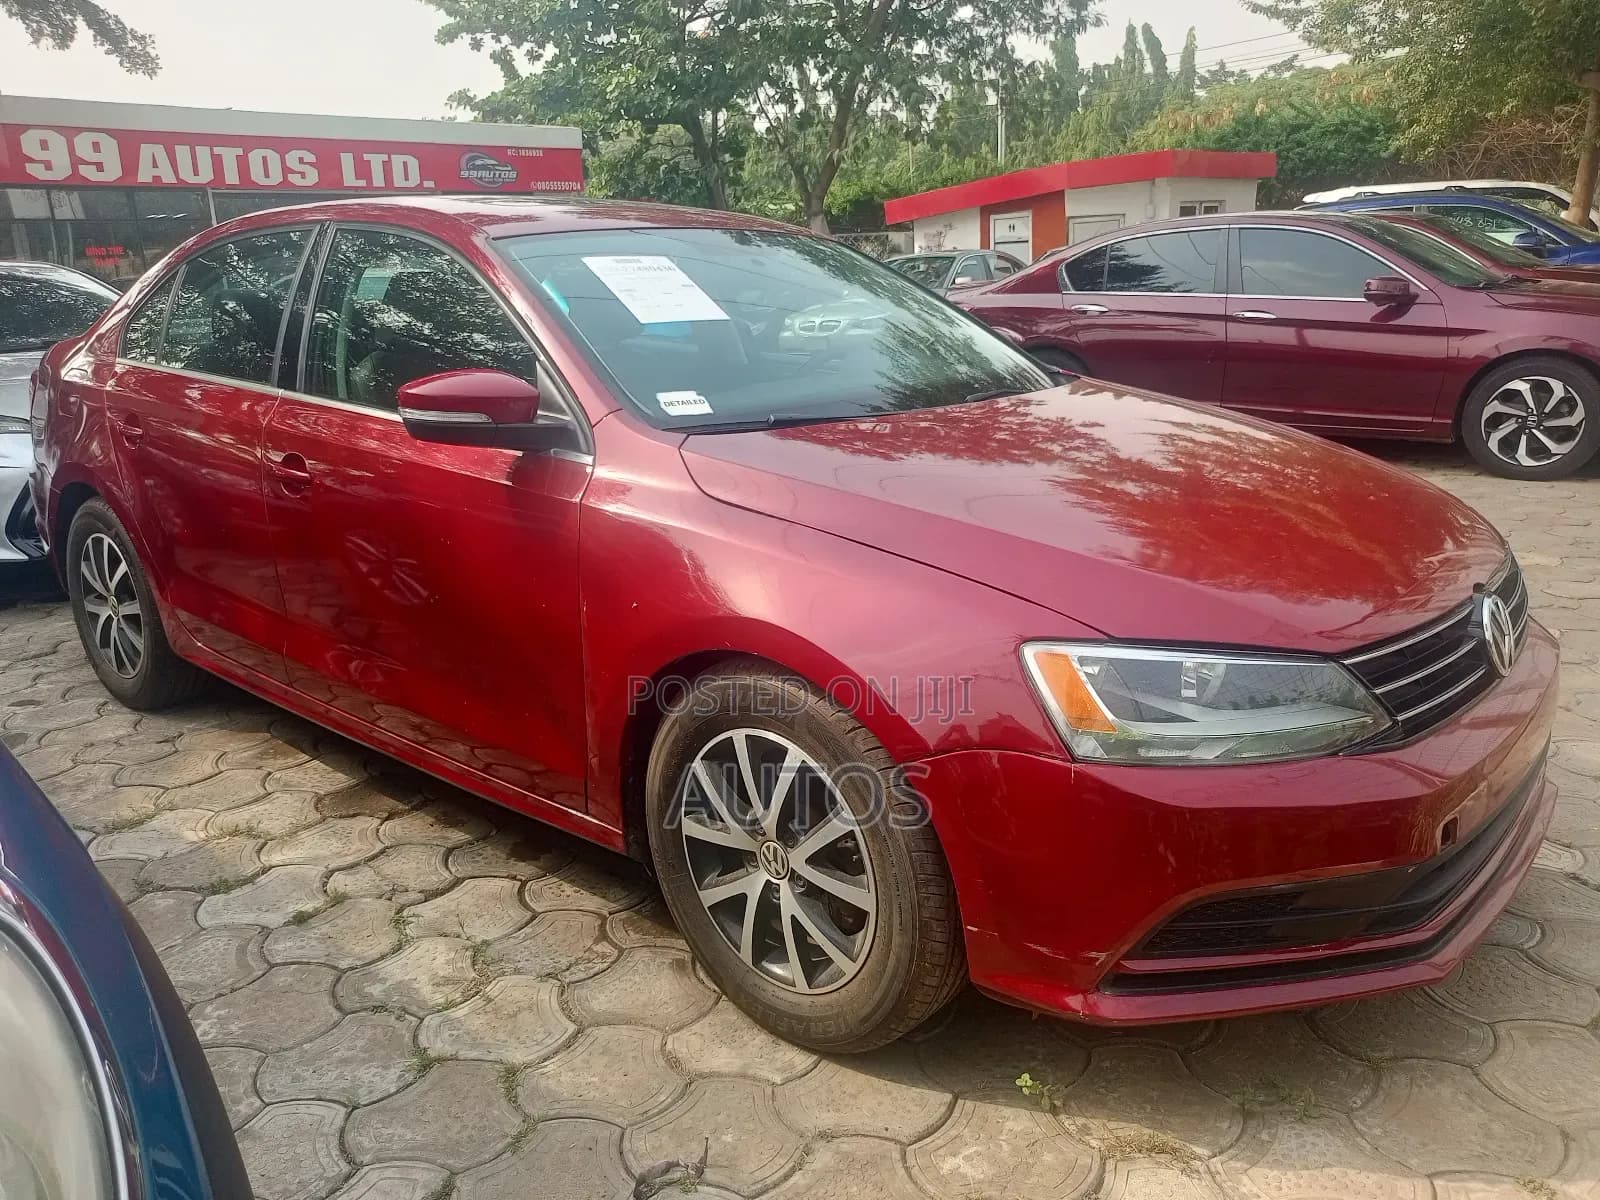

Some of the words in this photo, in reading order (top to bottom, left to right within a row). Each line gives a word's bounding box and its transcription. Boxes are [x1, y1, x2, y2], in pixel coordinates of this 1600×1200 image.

[20, 128, 123, 182] 99
[136, 143, 319, 188] AUTOS
[339, 152, 435, 188] LTD.
[663, 398, 706, 408] DETAILED
